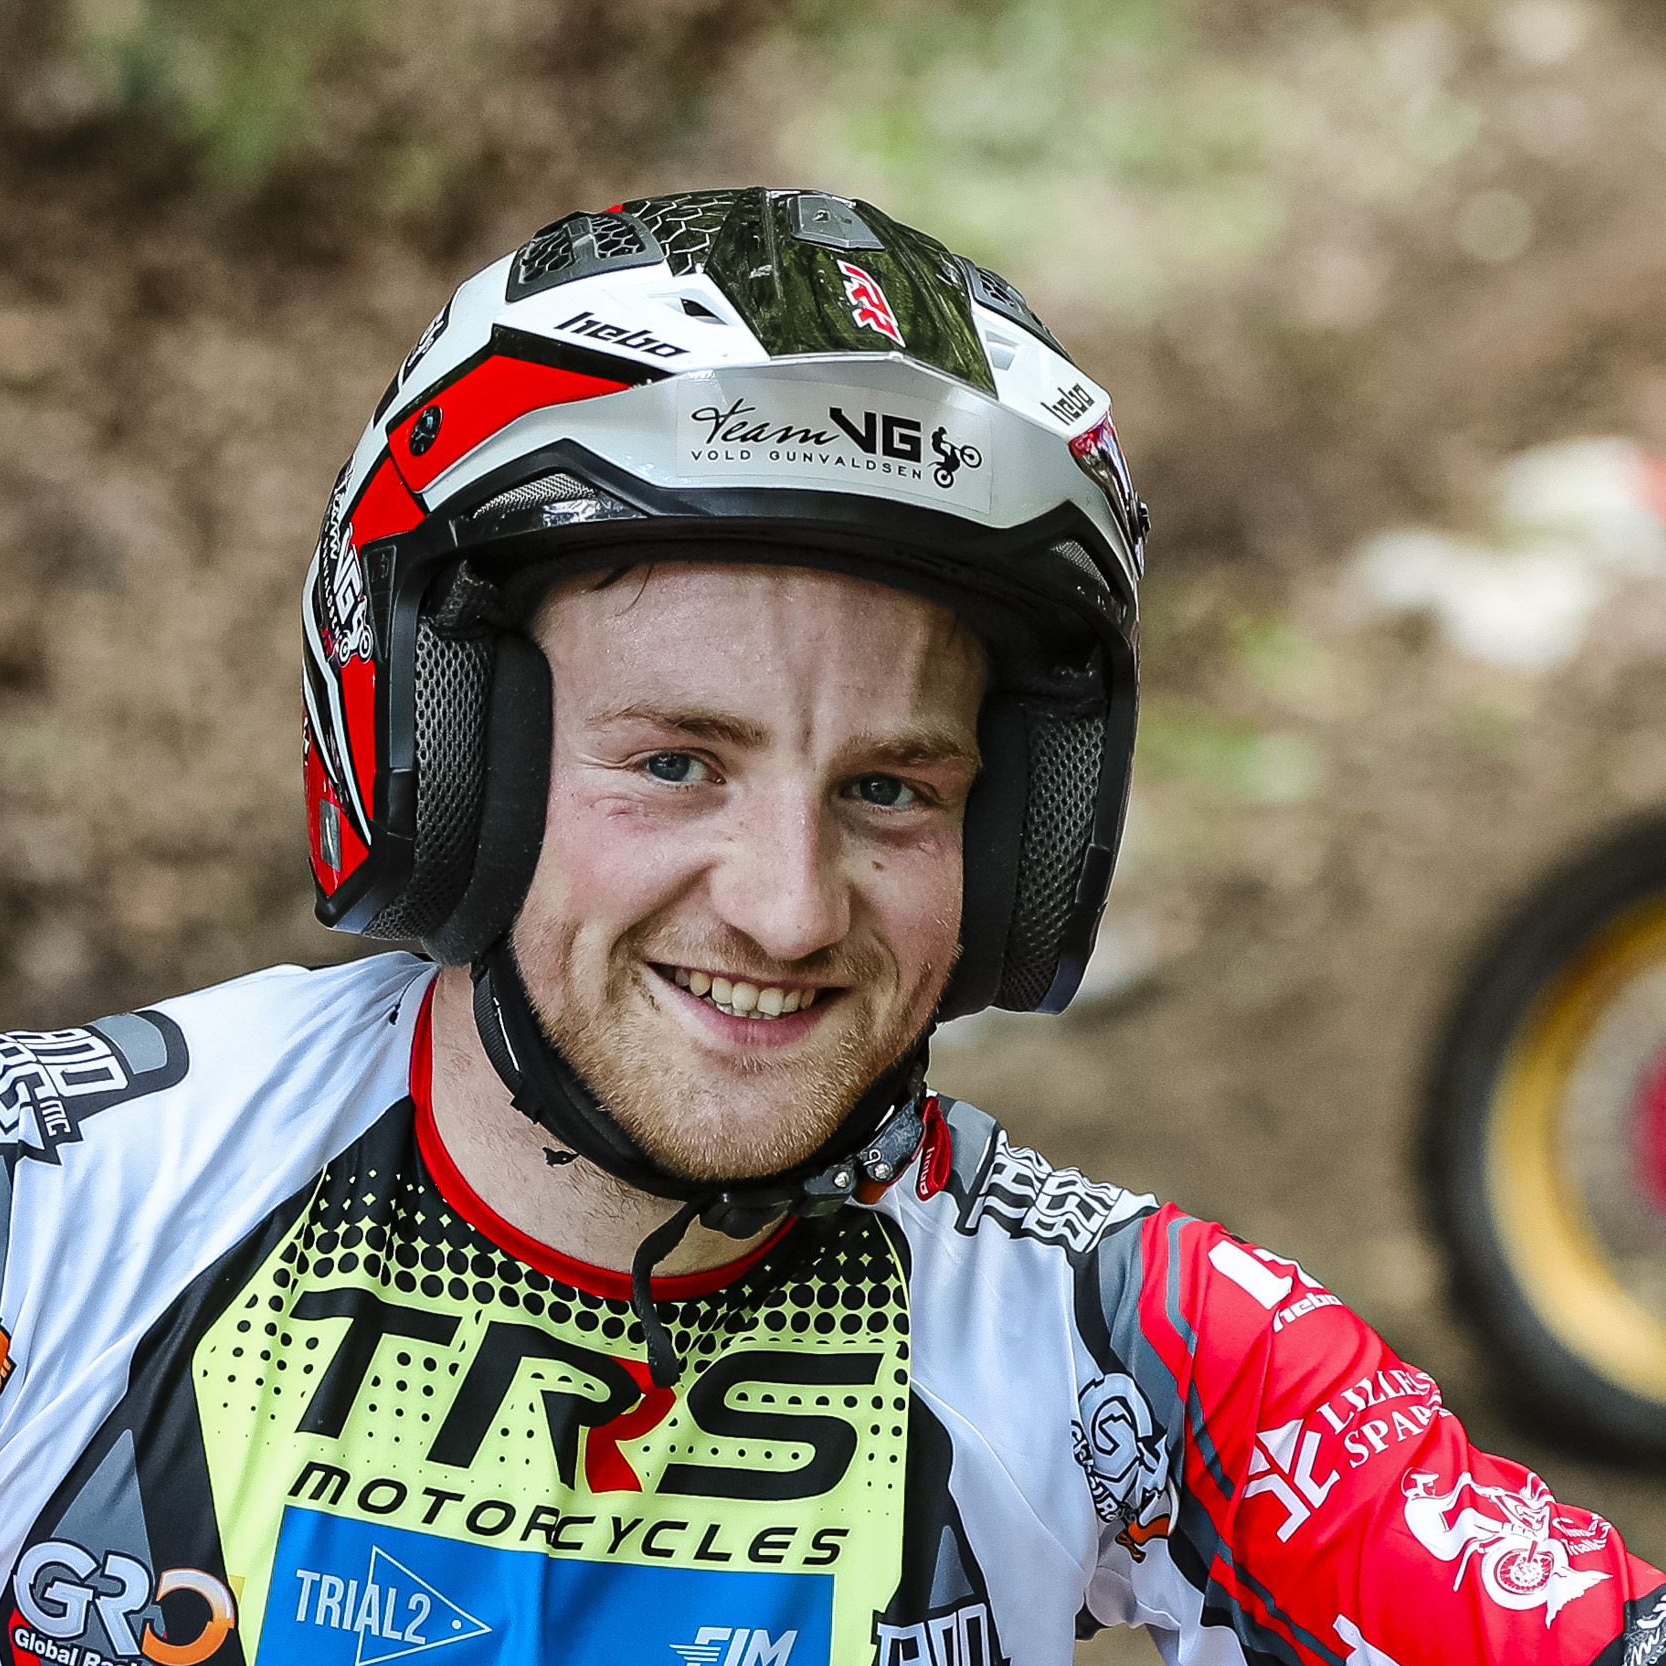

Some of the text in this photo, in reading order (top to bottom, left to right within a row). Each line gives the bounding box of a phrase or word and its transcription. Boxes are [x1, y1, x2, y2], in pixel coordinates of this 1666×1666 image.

[553, 311, 691, 358] hebo
[829, 406, 923, 463] VG
[691, 450, 923, 480] VOLD GUNVALDSEN
[287, 1286, 884, 1502] TRS
[287, 1460, 851, 1567] MOTORCYCLES
[295, 1569, 429, 1646] TRIAL2
[14, 1627, 78, 1666] Global
